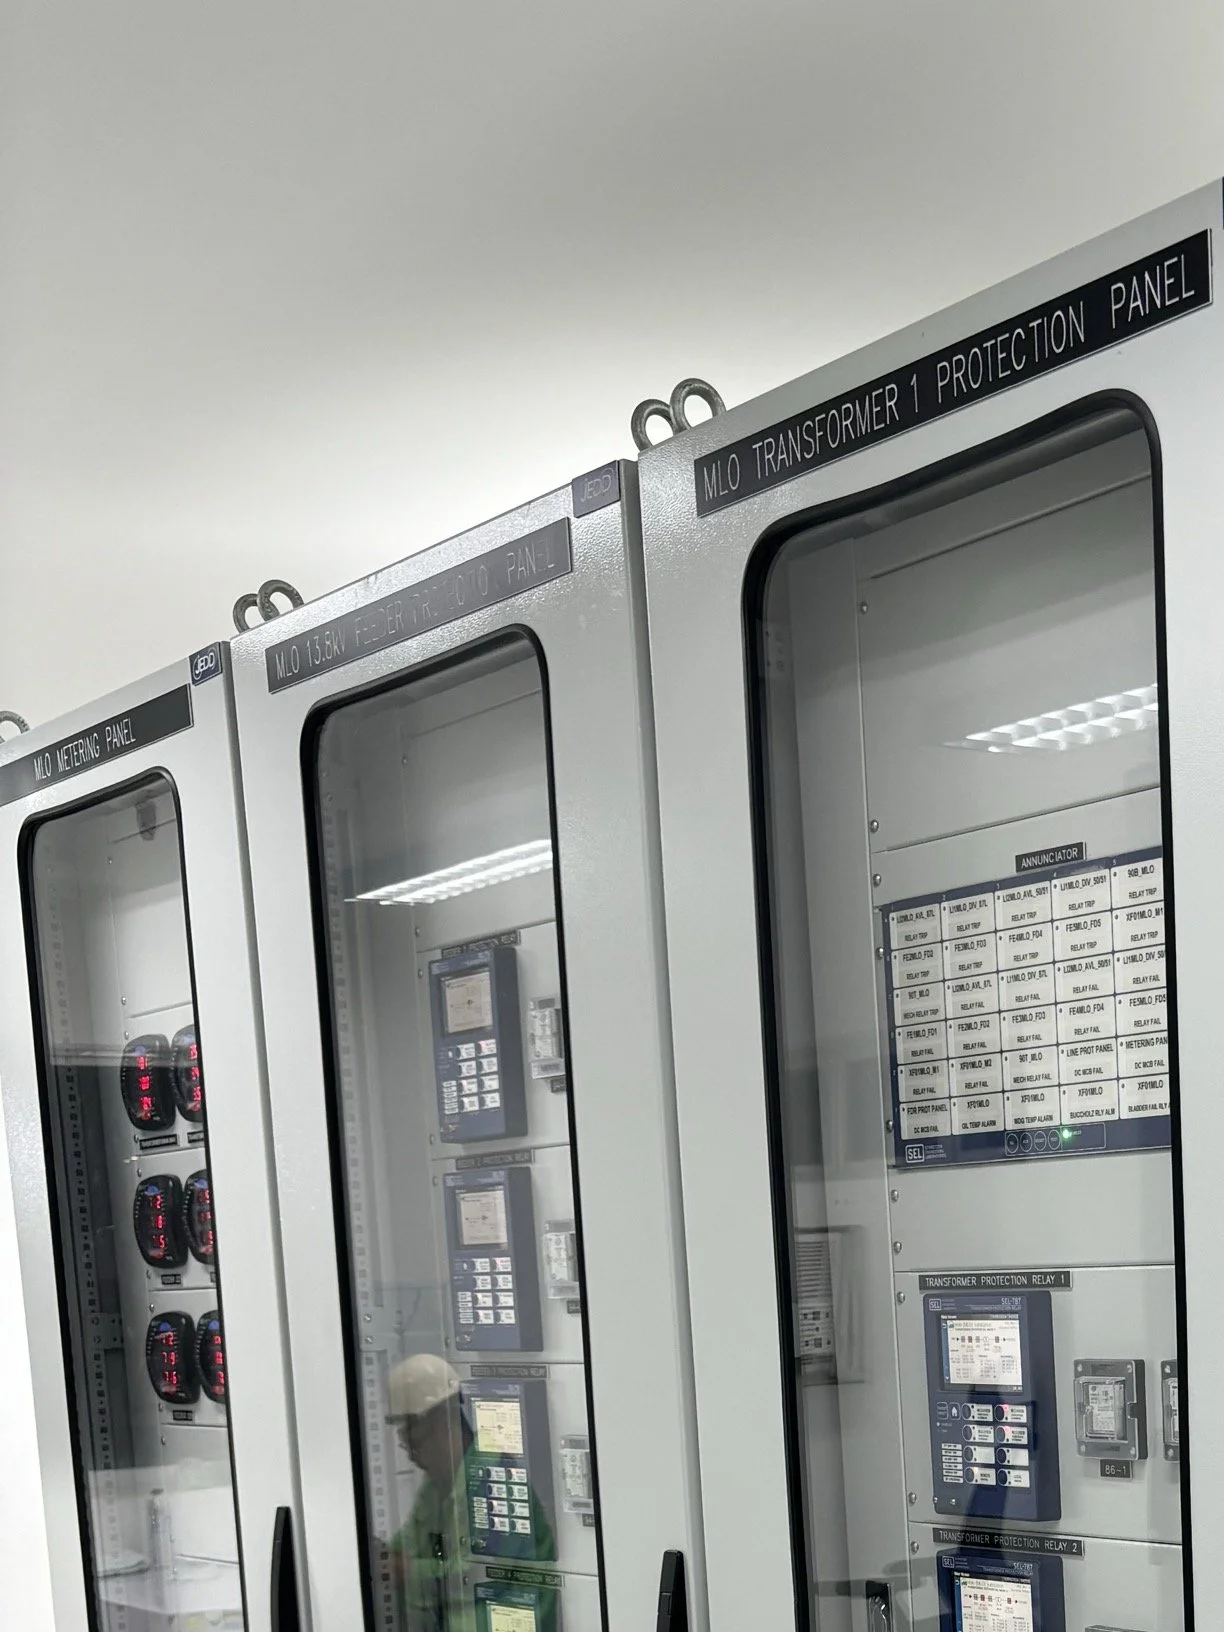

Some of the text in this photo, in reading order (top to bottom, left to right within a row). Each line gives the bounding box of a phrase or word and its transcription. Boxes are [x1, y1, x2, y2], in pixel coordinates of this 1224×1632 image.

[703, 254, 1195, 501] MLO TRANSFORMER 1 PROTECTION PANEL
[275, 645, 300, 680] MLO
[306, 626, 346, 666] 13.8kV
[33, 718, 136, 781] MLO METERING PANEL
[1021, 847, 1078, 869] ANNUNCIATOR
[1066, 1044, 1113, 1058] LINE PROT PANEL
[1126, 1038, 1154, 1049] METERING
[908, 1148, 922, 1160] SEL
[925, 1273, 1065, 1288] TRANSFORMER PROTECTION RELAY 1
[1105, 1463, 1126, 1475] 86-1
[939, 1530, 1078, 1553] TRANSFORMER PROTECTION RELAY 2
